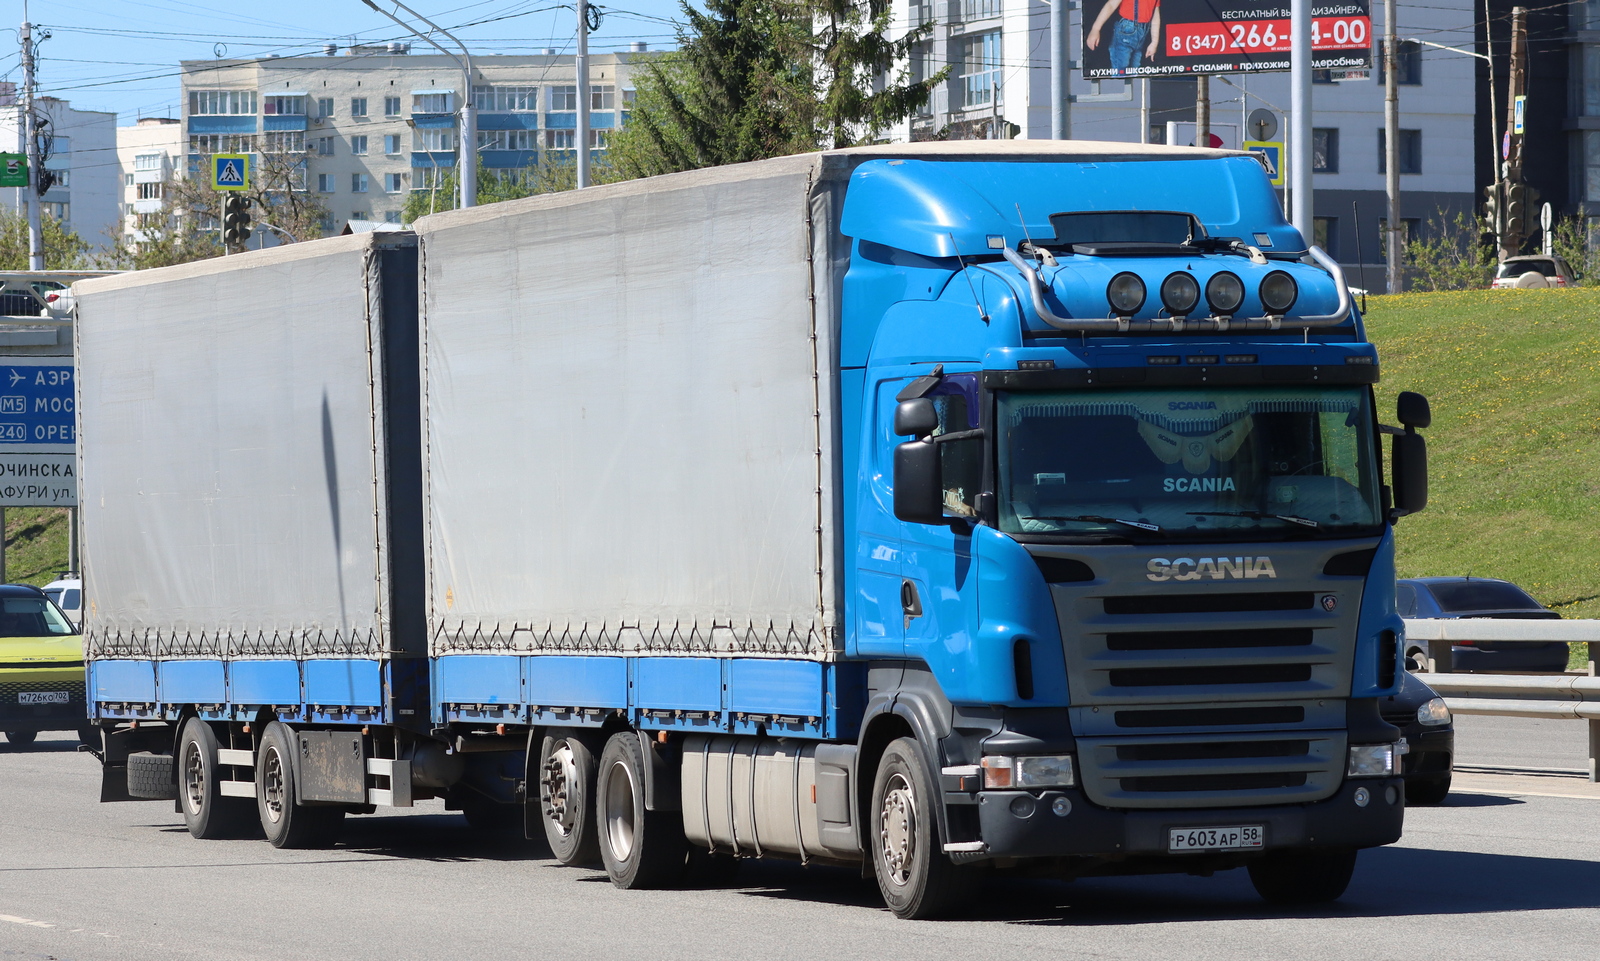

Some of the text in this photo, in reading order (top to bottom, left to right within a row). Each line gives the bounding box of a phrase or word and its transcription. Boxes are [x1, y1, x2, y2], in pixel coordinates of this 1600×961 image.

[1221, 8, 1279, 19] БЕСПЛАТНЫЙ
[1171, 19, 1366, 53] 8 (347) 266-4-00
[1090, 57, 1365, 77] кухни шкафы-купе спальни прихожие деробные
[35, 371, 74, 386] АЭР
[2, 399, 24, 411] М5
[1168, 401, 1217, 411] SCANIA
[0, 463, 74, 477] ЧИНСКА
[1163, 477, 1236, 492] SCANIA
[53, 488, 74, 502] ул.
[1146, 556, 1278, 582] SCANIA
[1242, 828, 1258, 840] 58
